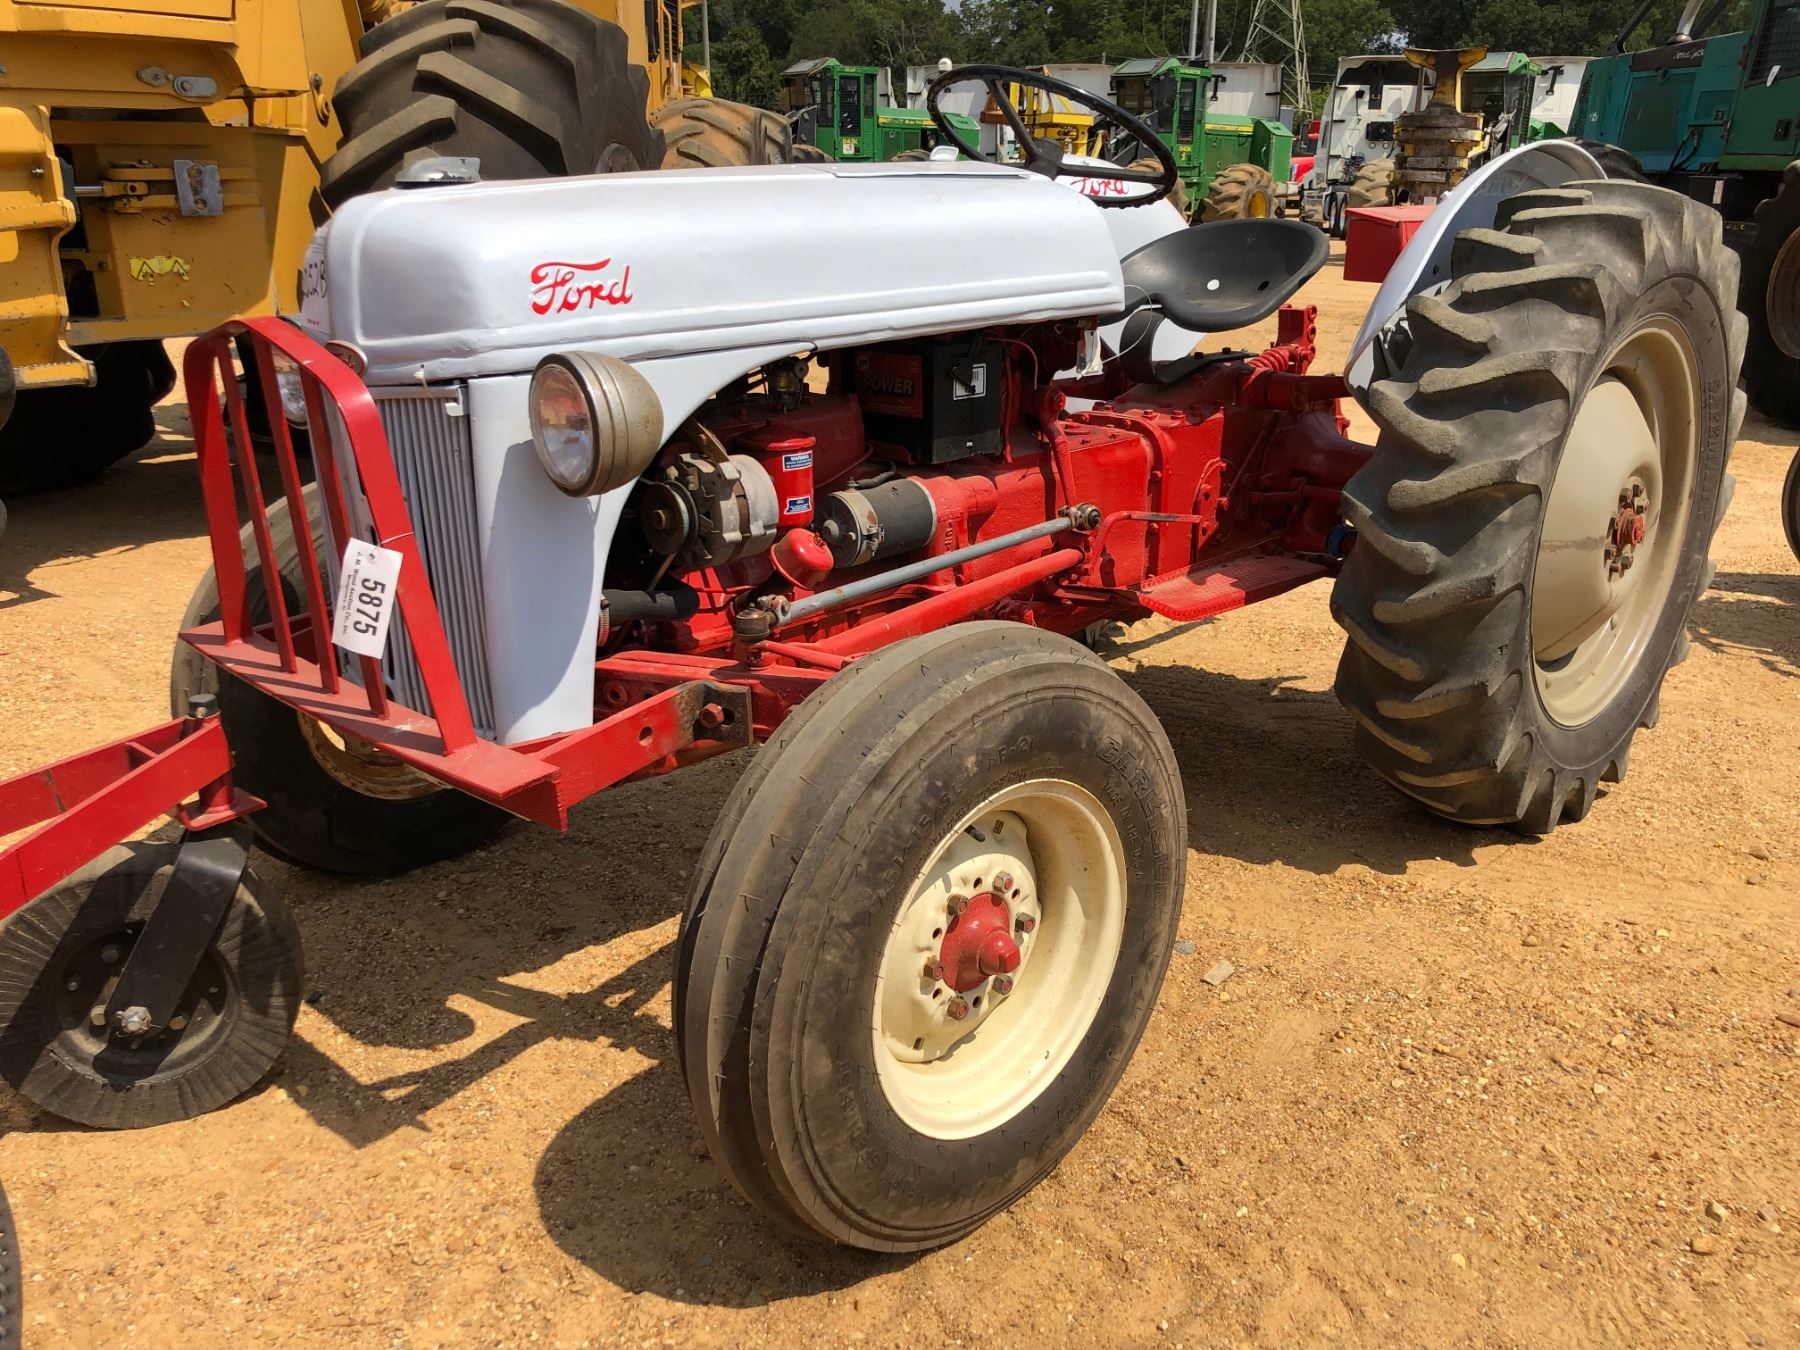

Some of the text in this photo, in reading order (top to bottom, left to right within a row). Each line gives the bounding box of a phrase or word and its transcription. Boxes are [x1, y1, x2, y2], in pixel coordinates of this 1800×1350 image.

[531, 257, 634, 315] Ford
[863, 375, 914, 395] POWER
[353, 578, 386, 636] 5875
[1096, 735, 1169, 904] CARLISLE
[1125, 823, 1143, 846] THE
